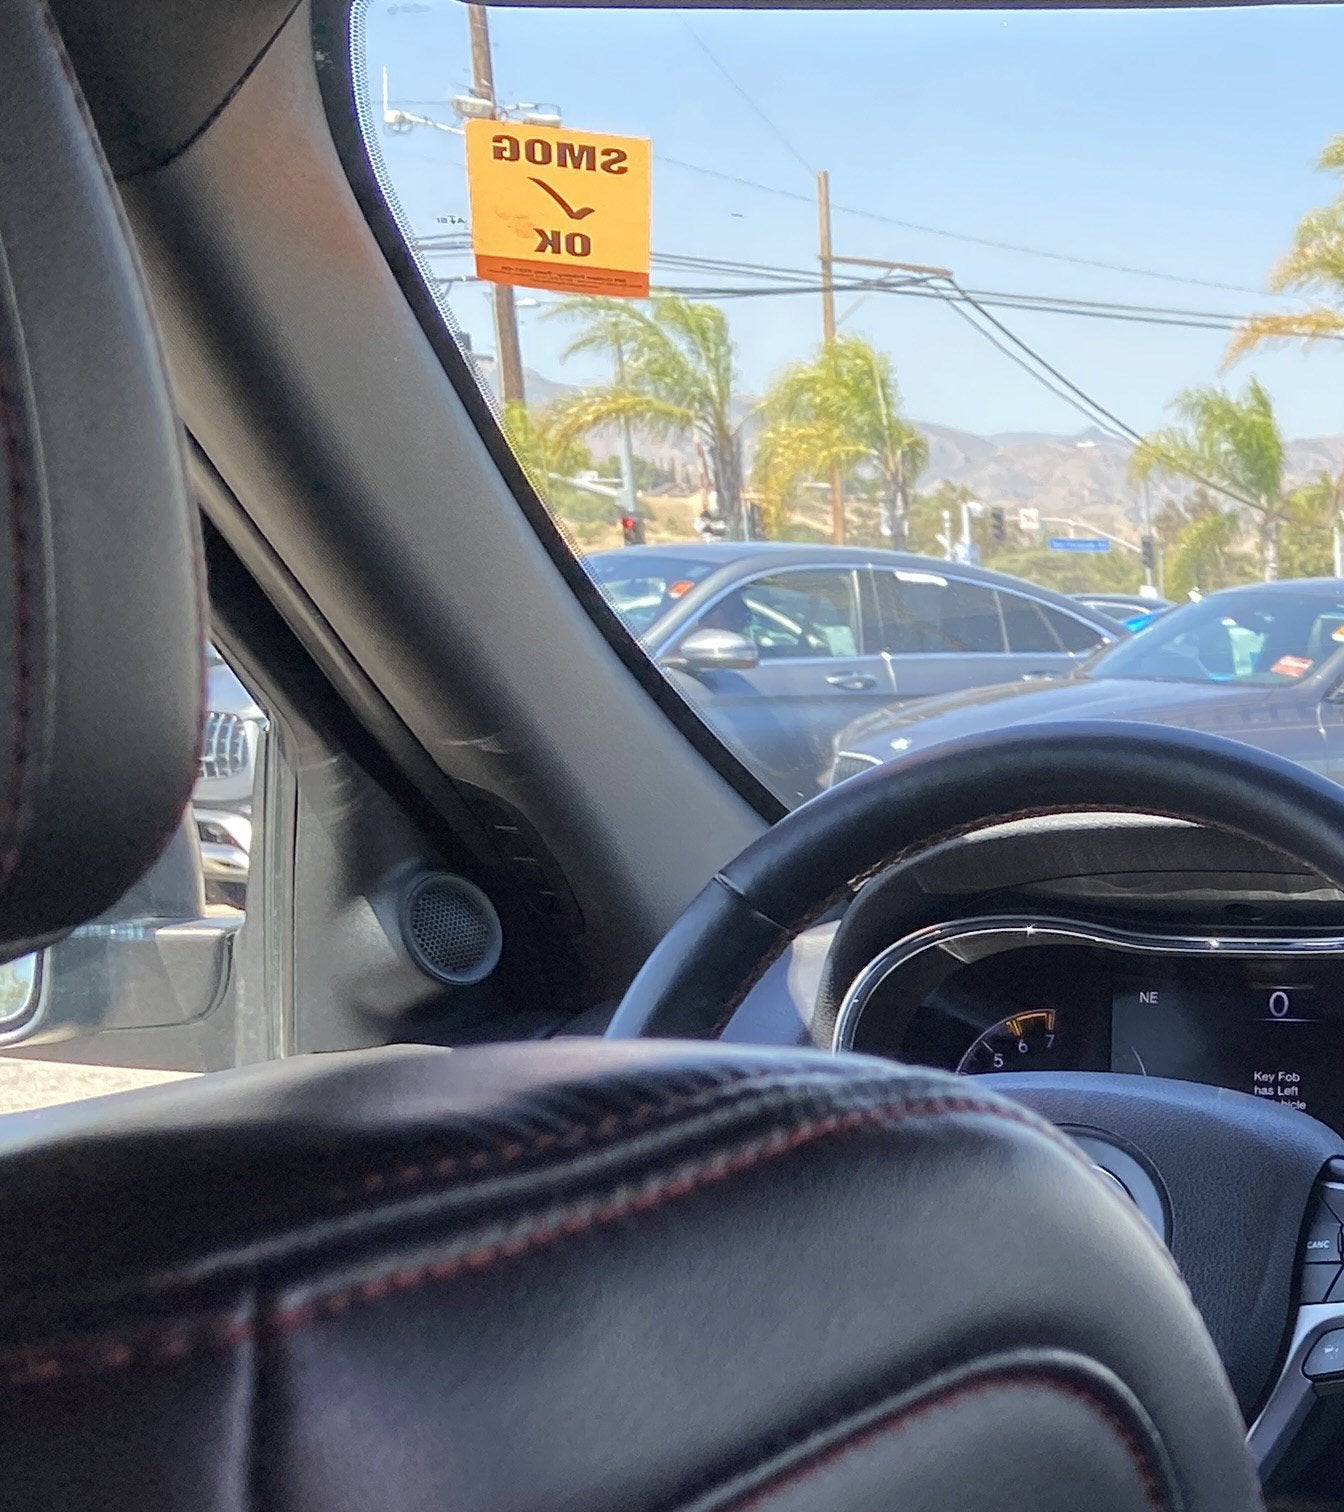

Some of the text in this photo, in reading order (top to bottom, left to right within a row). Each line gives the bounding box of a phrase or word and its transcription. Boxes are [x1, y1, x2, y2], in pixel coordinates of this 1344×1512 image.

[1139, 992, 1159, 1004] NE
[1269, 991, 1289, 1017] 0
[1018, 1039, 1029, 1053] 6
[1045, 1034, 1055, 1048] 7
[993, 1053, 1004, 1068] 5
[1254, 1071, 1300, 1084] Key Fob
[1254, 1085, 1299, 1095] has Left
[1307, 1240, 1330, 1249] CANC
